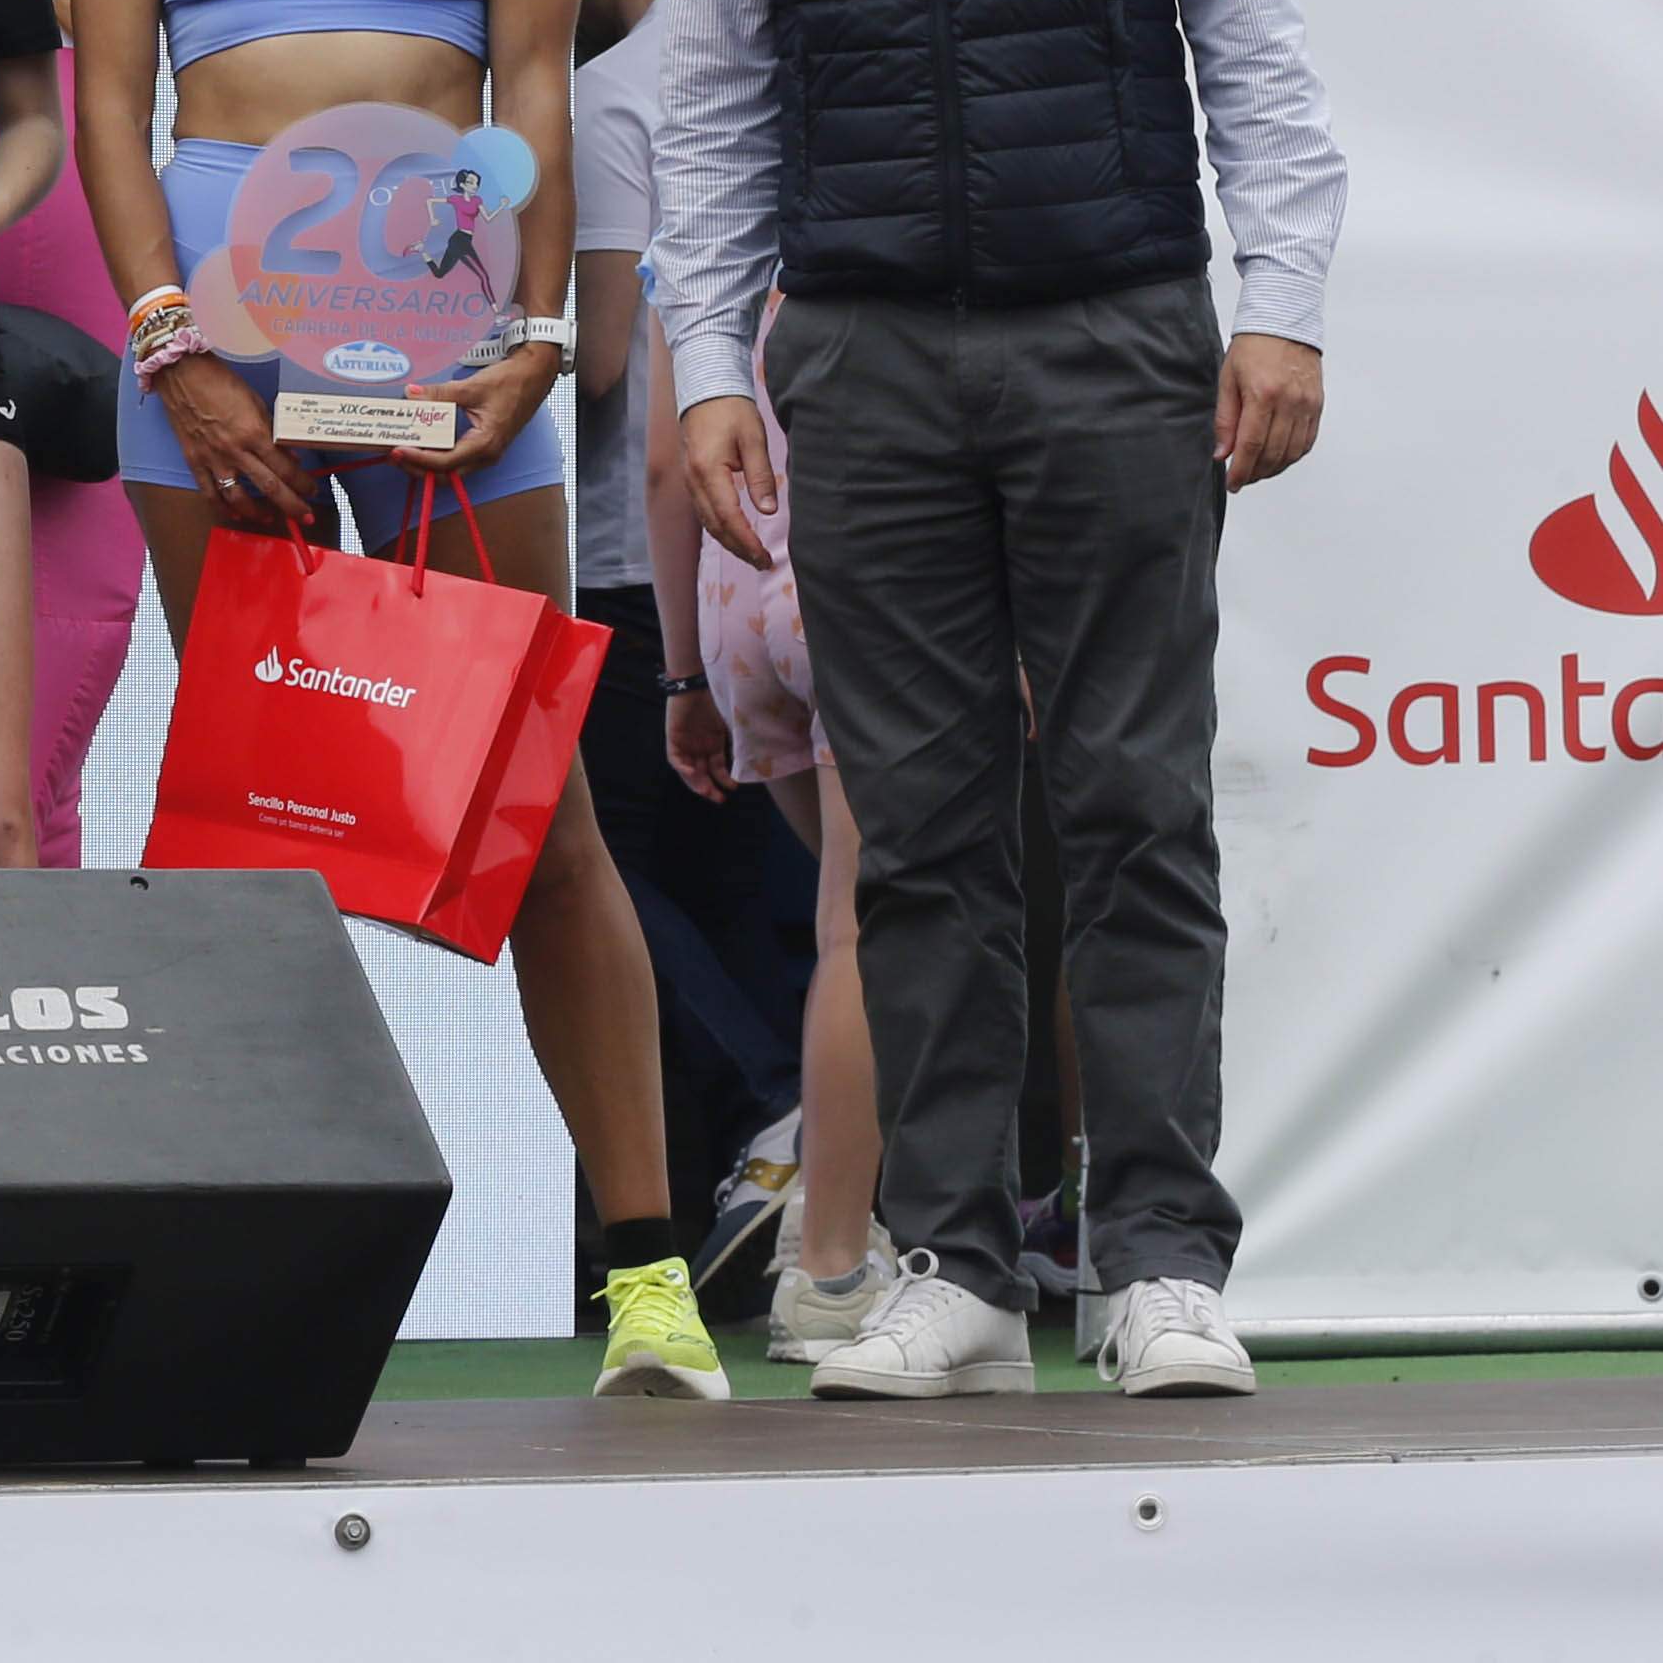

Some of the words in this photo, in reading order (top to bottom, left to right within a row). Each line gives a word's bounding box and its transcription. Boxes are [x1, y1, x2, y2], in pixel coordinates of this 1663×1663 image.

[261, 146, 458, 282] 20
[237, 280, 489, 318] ANIVERSARIO
[330, 353, 404, 373] ASTURIANA
[338, 403, 359, 414] XIX
[359, 405, 395, 417] Carrera
[413, 407, 448, 426] Mujer
[283, 658, 417, 709] Santander
[248, 792, 284, 811] Sencillo
[286, 799, 329, 819] Personal
[330, 809, 356, 826] Justo
